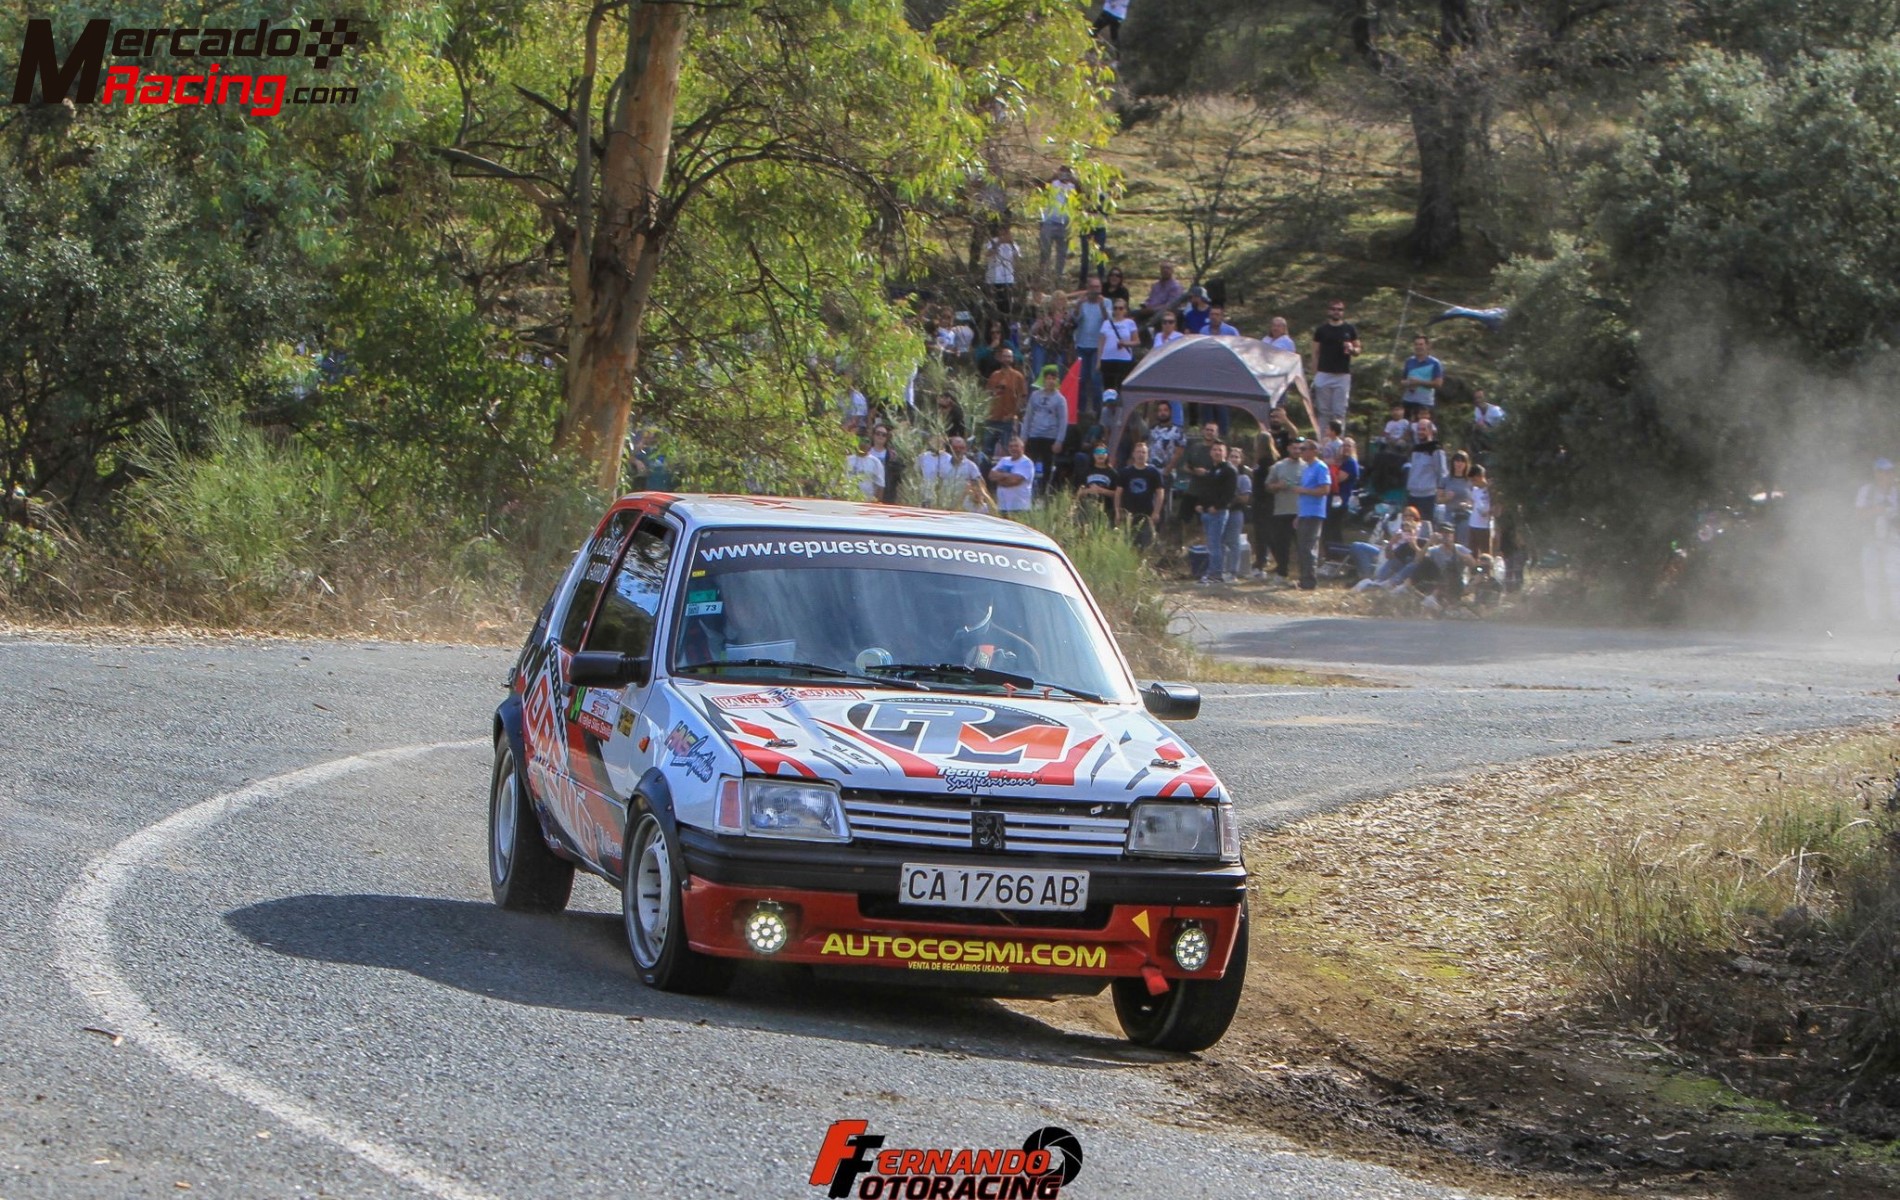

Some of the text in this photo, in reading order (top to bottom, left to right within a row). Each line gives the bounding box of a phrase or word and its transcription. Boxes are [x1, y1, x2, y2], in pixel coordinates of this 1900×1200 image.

[700, 539, 1047, 575] www.repuestosmoreno.co
[705, 604, 717, 612] 73
[908, 869, 1081, 906] CA 1766 AB
[820, 932, 1107, 969] AUTOCOSMI.COM
[907, 961, 1010, 974] VENTA DE RECAMBIOS USADOS
